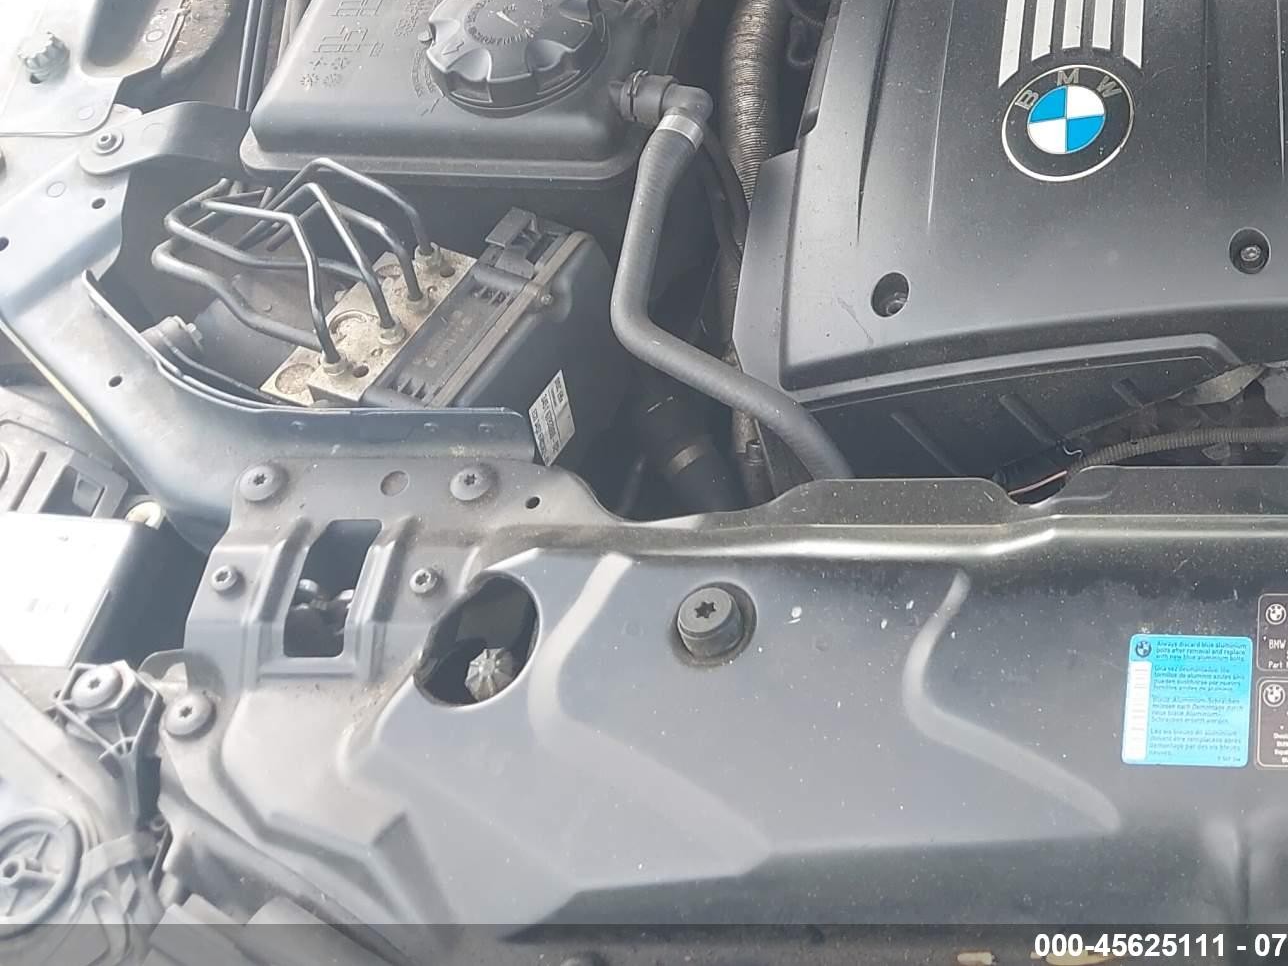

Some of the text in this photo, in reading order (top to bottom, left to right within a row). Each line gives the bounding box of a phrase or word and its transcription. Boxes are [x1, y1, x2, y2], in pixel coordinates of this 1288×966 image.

[1015, 67, 1122, 110] BMW
[1268, 639, 1286, 650] BMW
[1268, 661, 1283, 669] Part
